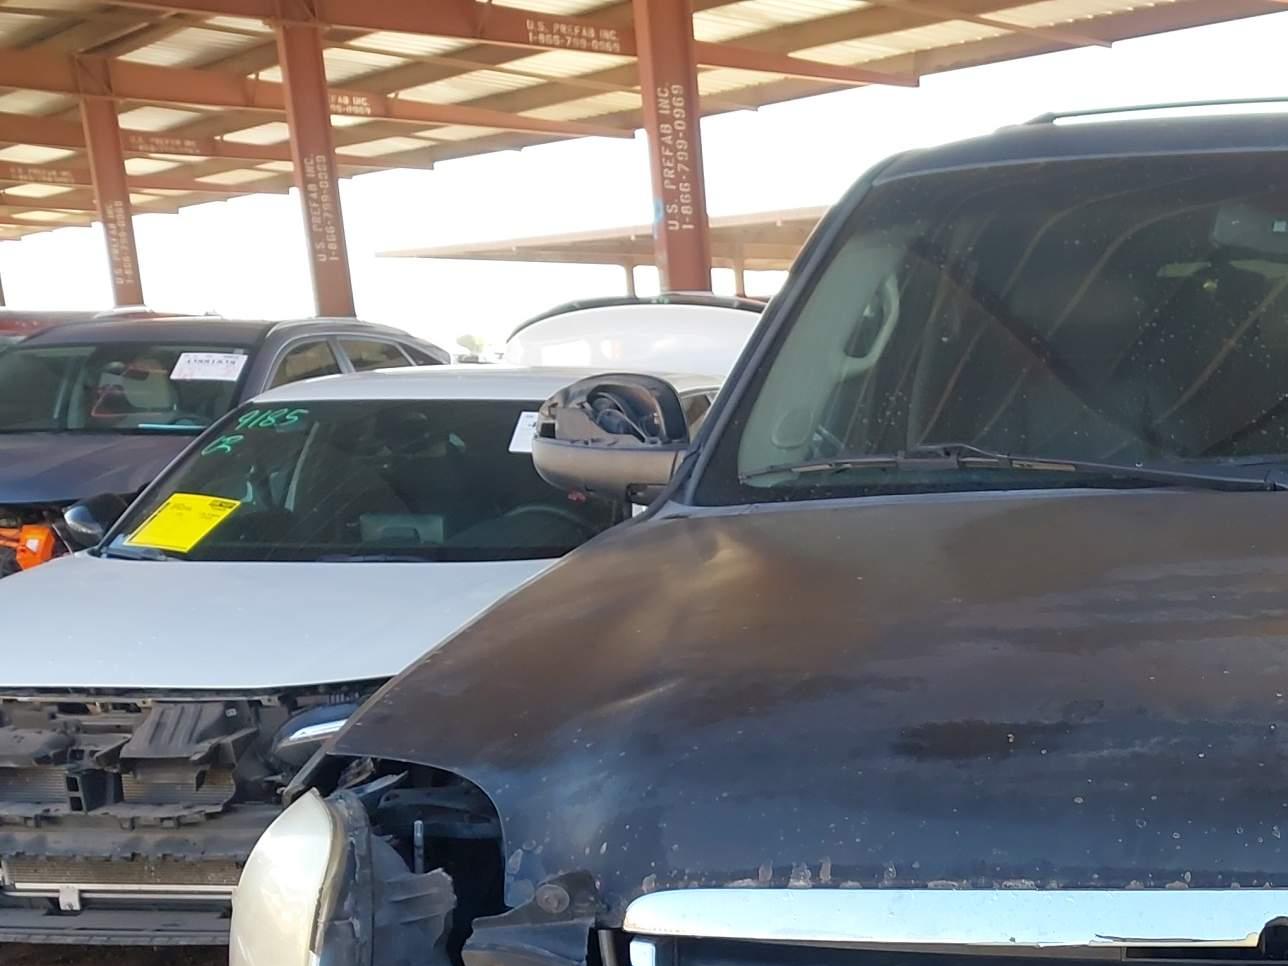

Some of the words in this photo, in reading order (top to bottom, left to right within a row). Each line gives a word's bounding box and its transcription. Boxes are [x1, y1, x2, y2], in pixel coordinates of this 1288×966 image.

[552, 22, 596, 39] PREFAB
[660, 123, 678, 190] PREFAB
[671, 84, 696, 230] 1-866-799-0969
